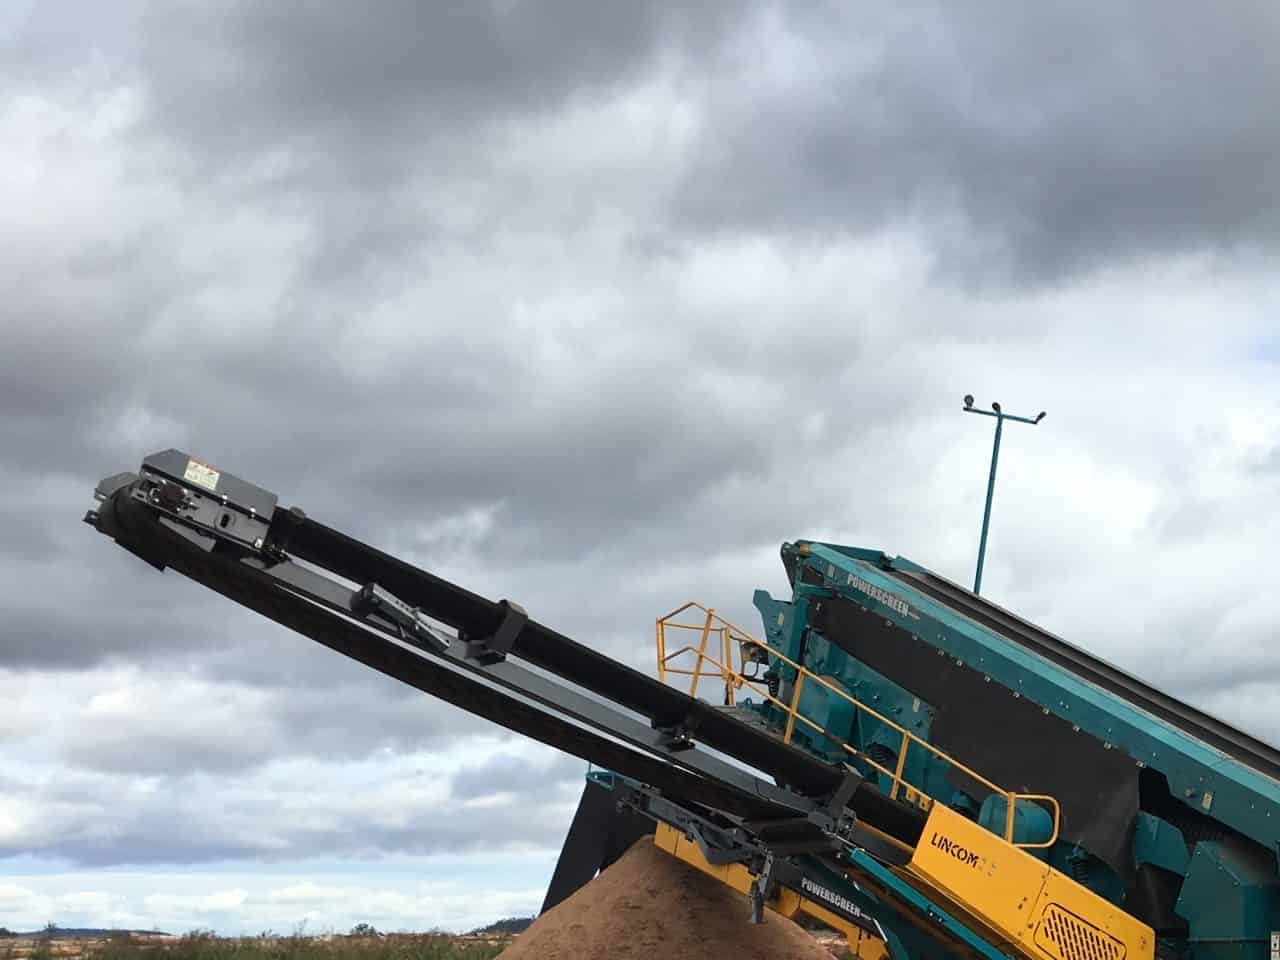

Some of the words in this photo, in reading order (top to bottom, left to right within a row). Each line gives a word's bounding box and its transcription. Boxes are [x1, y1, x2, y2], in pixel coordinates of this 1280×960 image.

[847, 573, 909, 617] POWERSCREEN
[930, 831, 979, 869] LINCOM
[801, 877, 861, 917] POWERSCREEN
